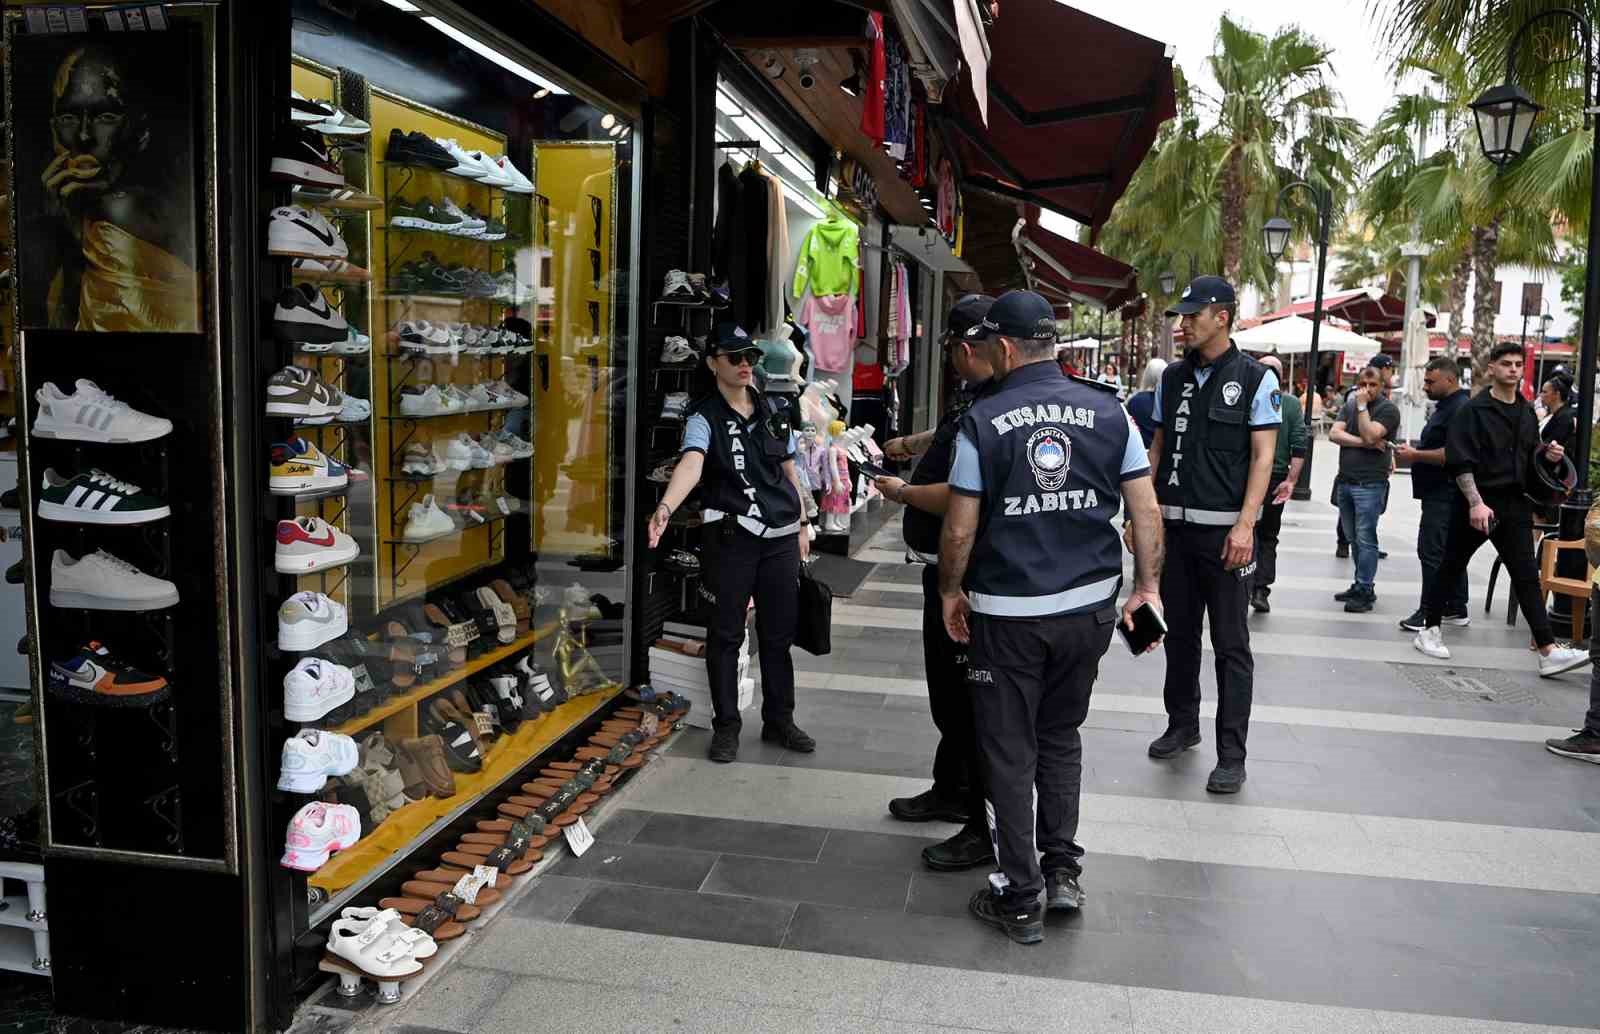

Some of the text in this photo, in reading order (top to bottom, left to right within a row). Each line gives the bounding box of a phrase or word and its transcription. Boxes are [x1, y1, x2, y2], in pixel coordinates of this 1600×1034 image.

[991, 404, 1096, 436] KUŞADASI
[1167, 382, 1193, 487] ZABITA
[726, 420, 763, 518] ZABITA
[1004, 488, 1099, 516] ZABITA
